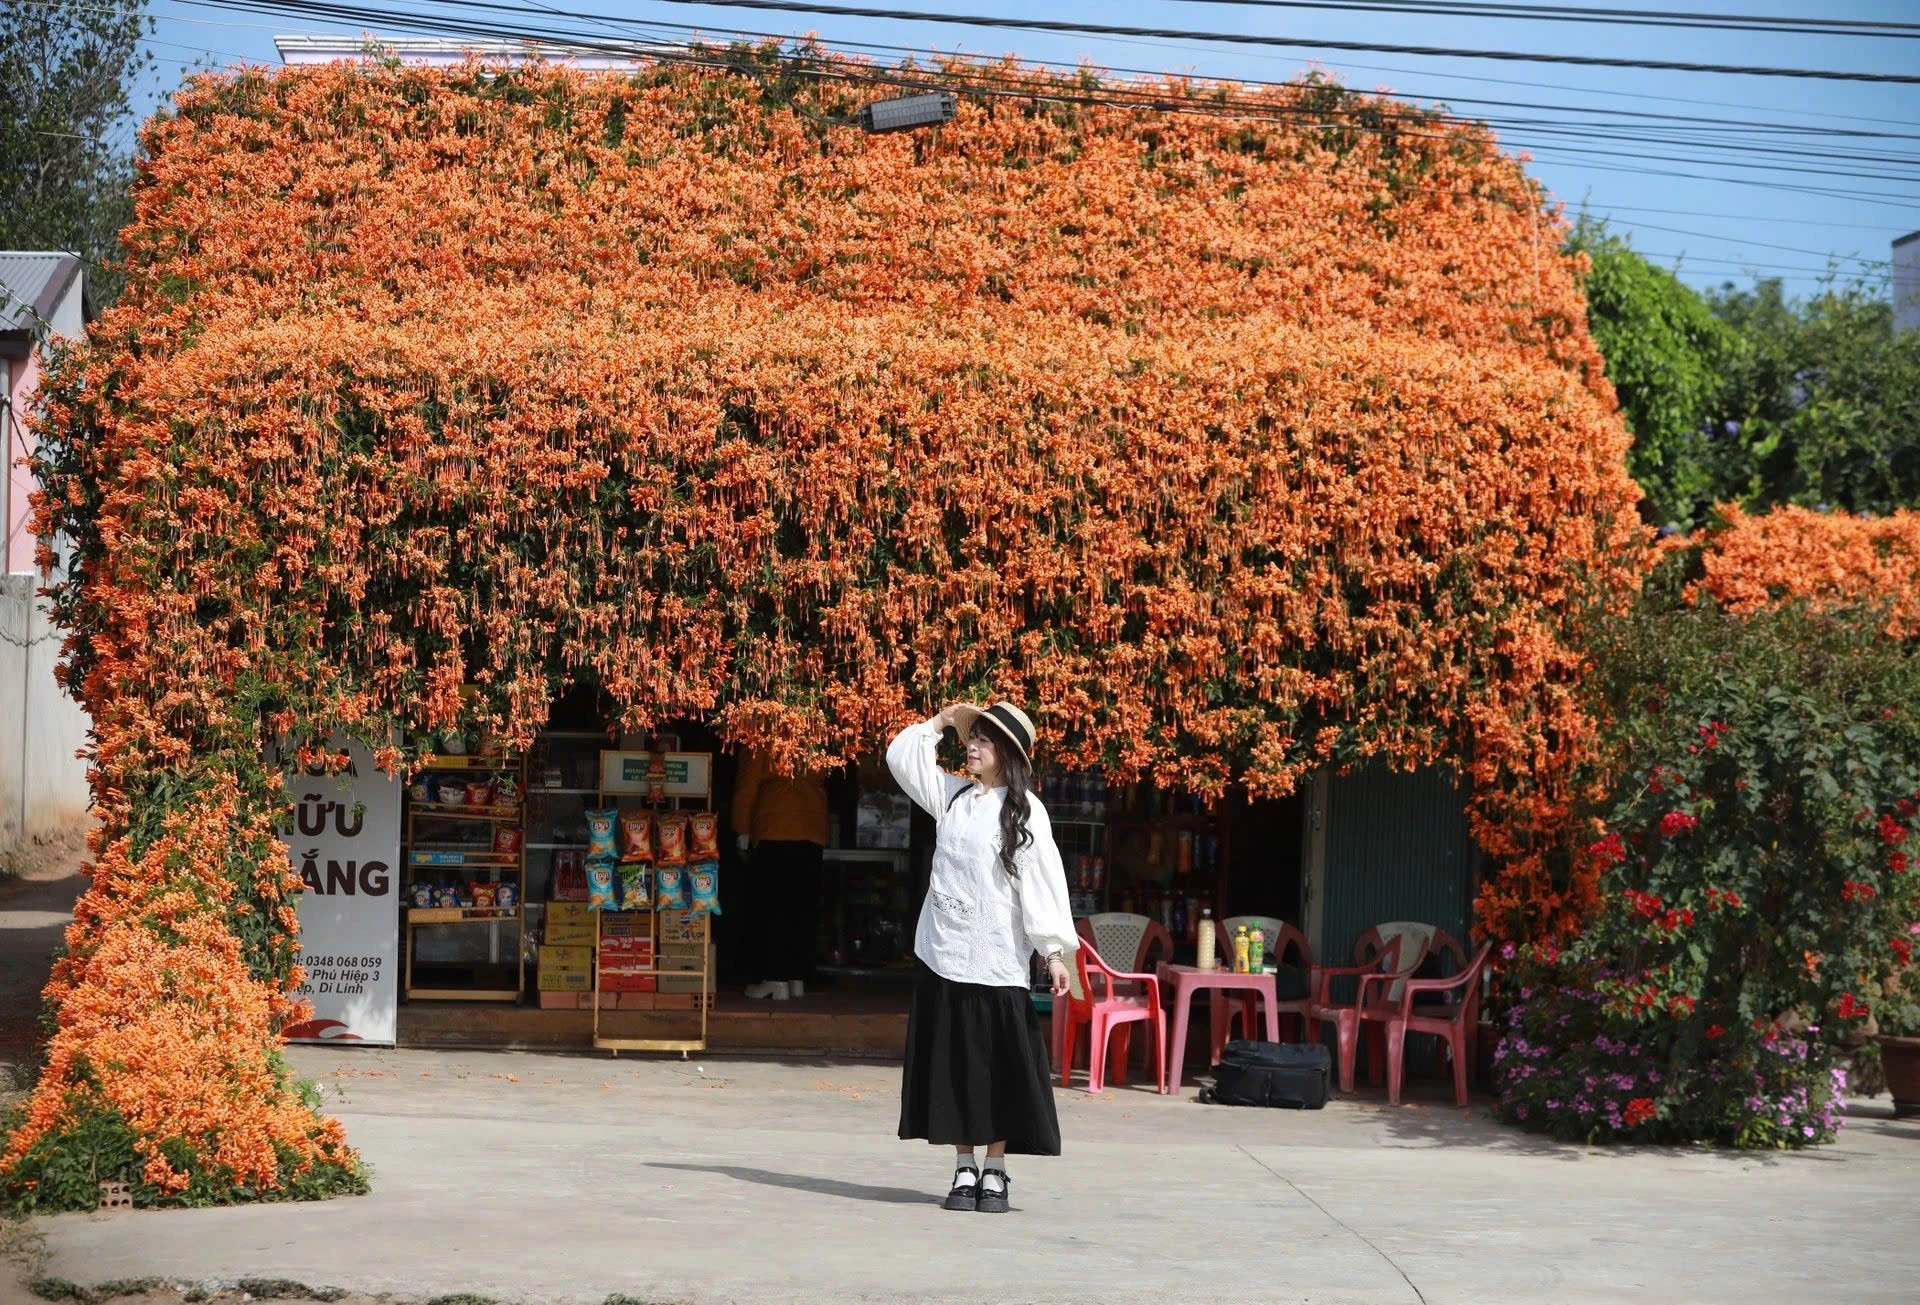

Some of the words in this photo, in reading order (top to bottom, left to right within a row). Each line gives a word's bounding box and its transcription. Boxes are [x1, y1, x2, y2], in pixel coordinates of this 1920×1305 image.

[289, 848, 390, 897] ẮNG
[306, 956, 334, 967] 0348
[336, 956, 358, 967] 068
[360, 957, 382, 968] 059
[312, 969, 337, 980] Phú
[341, 970, 369, 983] Hiệp
[372, 971, 380, 981] 3
[319, 982, 332, 993] Di
[336, 983, 363, 994] Linh
